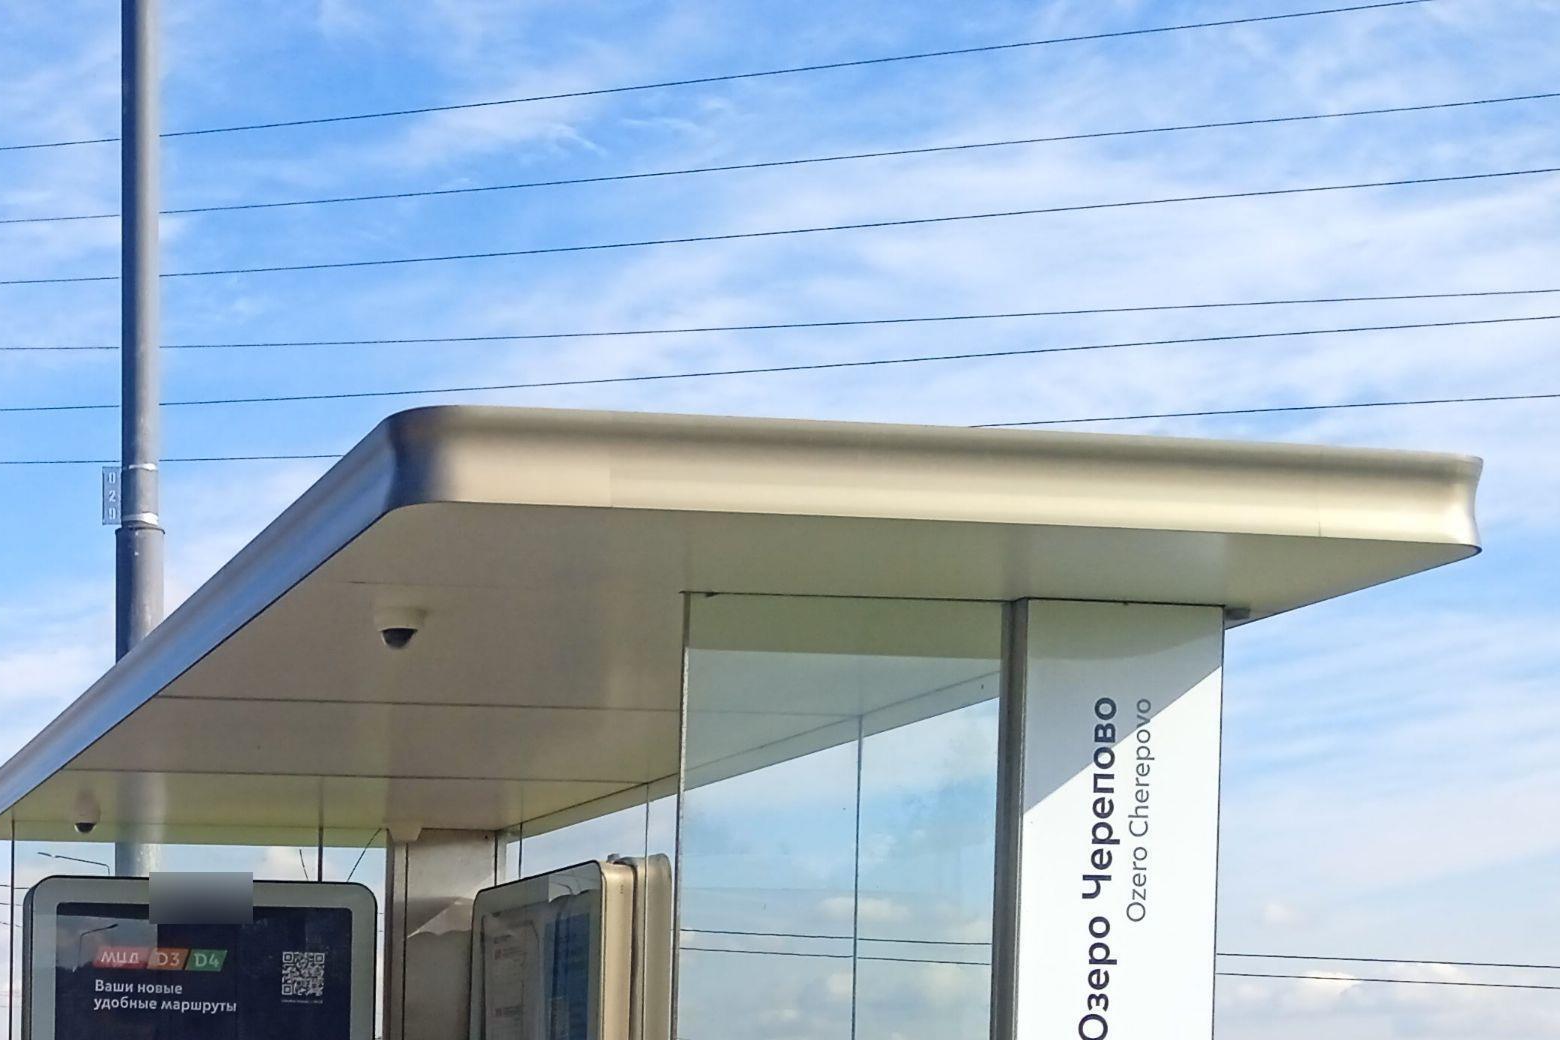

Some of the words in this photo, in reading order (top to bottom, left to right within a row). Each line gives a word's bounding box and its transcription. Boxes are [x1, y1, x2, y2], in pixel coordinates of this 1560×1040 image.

[1127, 698, 1155, 838] Cherepovo
[1081, 696, 1121, 900] Черепово
[1126, 846, 1148, 923] Ozero
[100, 951, 140, 965] МЦД
[155, 951, 180, 967] D3
[194, 952, 220, 968] D4
[93, 996, 157, 1011] удобные
[160, 1000, 237, 1014] маршруты
[95, 979, 134, 993] Ваши
[137, 983, 183, 995] новые
